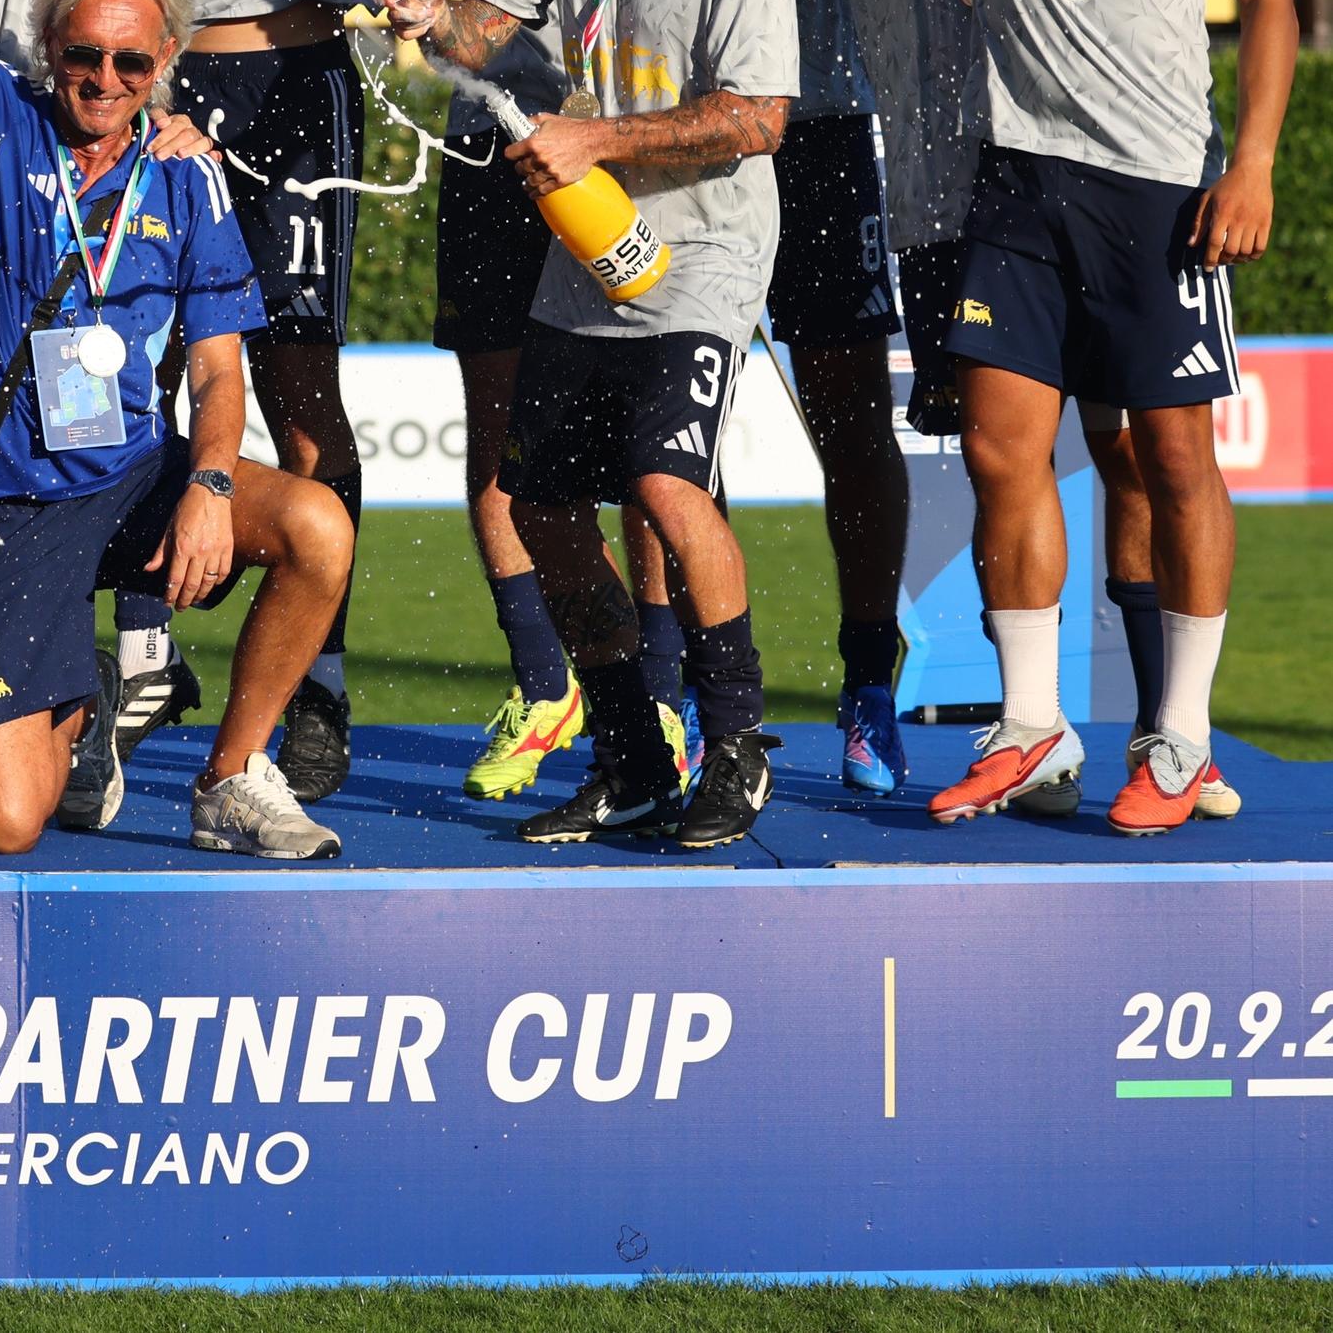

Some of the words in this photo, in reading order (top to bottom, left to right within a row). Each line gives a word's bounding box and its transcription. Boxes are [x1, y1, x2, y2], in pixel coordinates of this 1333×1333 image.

[288, 215, 326, 275] 11
[860, 214, 881, 273] 8
[1178, 264, 1207, 325] 4
[690, 345, 722, 408] 3
[485, 991, 734, 1104] CUP
